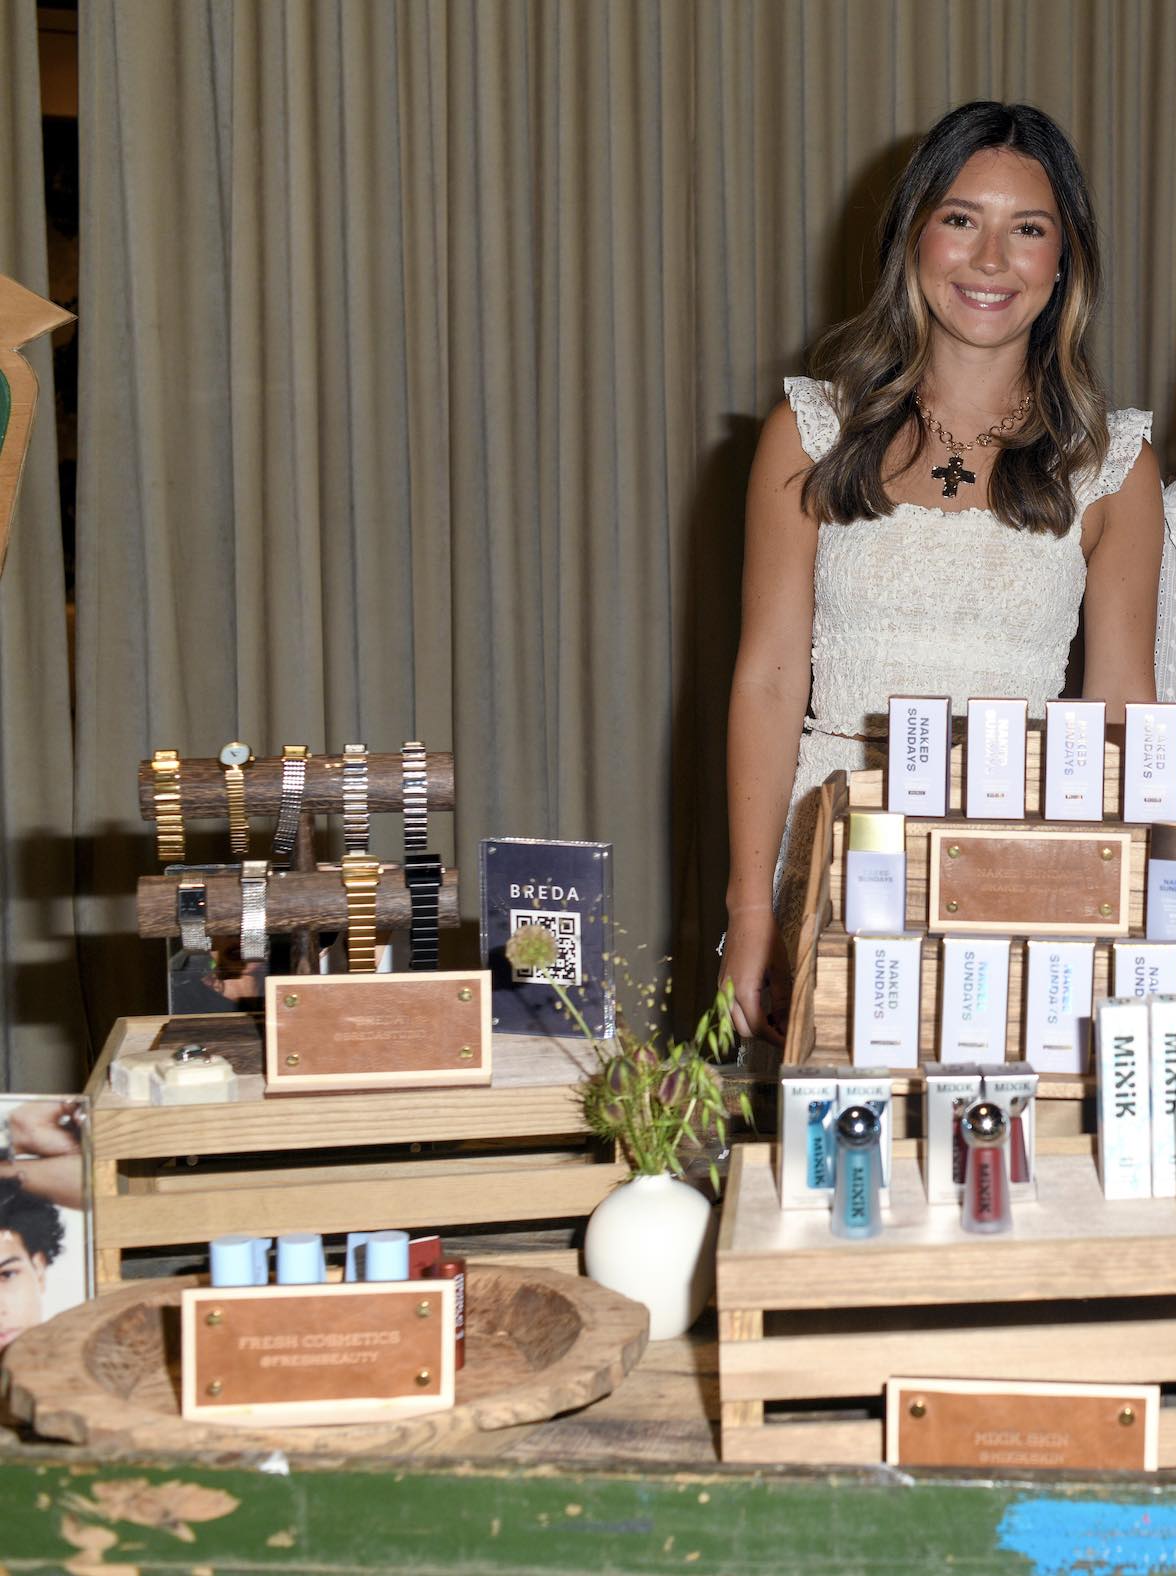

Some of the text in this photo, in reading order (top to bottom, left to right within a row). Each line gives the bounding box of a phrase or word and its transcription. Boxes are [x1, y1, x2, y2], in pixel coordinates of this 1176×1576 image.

[907, 708, 917, 772] SUNDAYS
[920, 717, 929, 763] NAKED
[510, 884, 579, 901] BREDA
[874, 950, 885, 1019] SUNDAYS
[888, 960, 899, 1010] NAKED
[962, 952, 975, 1021] SUNDAYS
[1135, 957, 1145, 998] SUND
[238, 1330, 400, 1350] FRESH COSMETICS
[260, 1352, 379, 1368] @FRESHBEAUTY
[1026, 1432, 1069, 1447] SKIN
